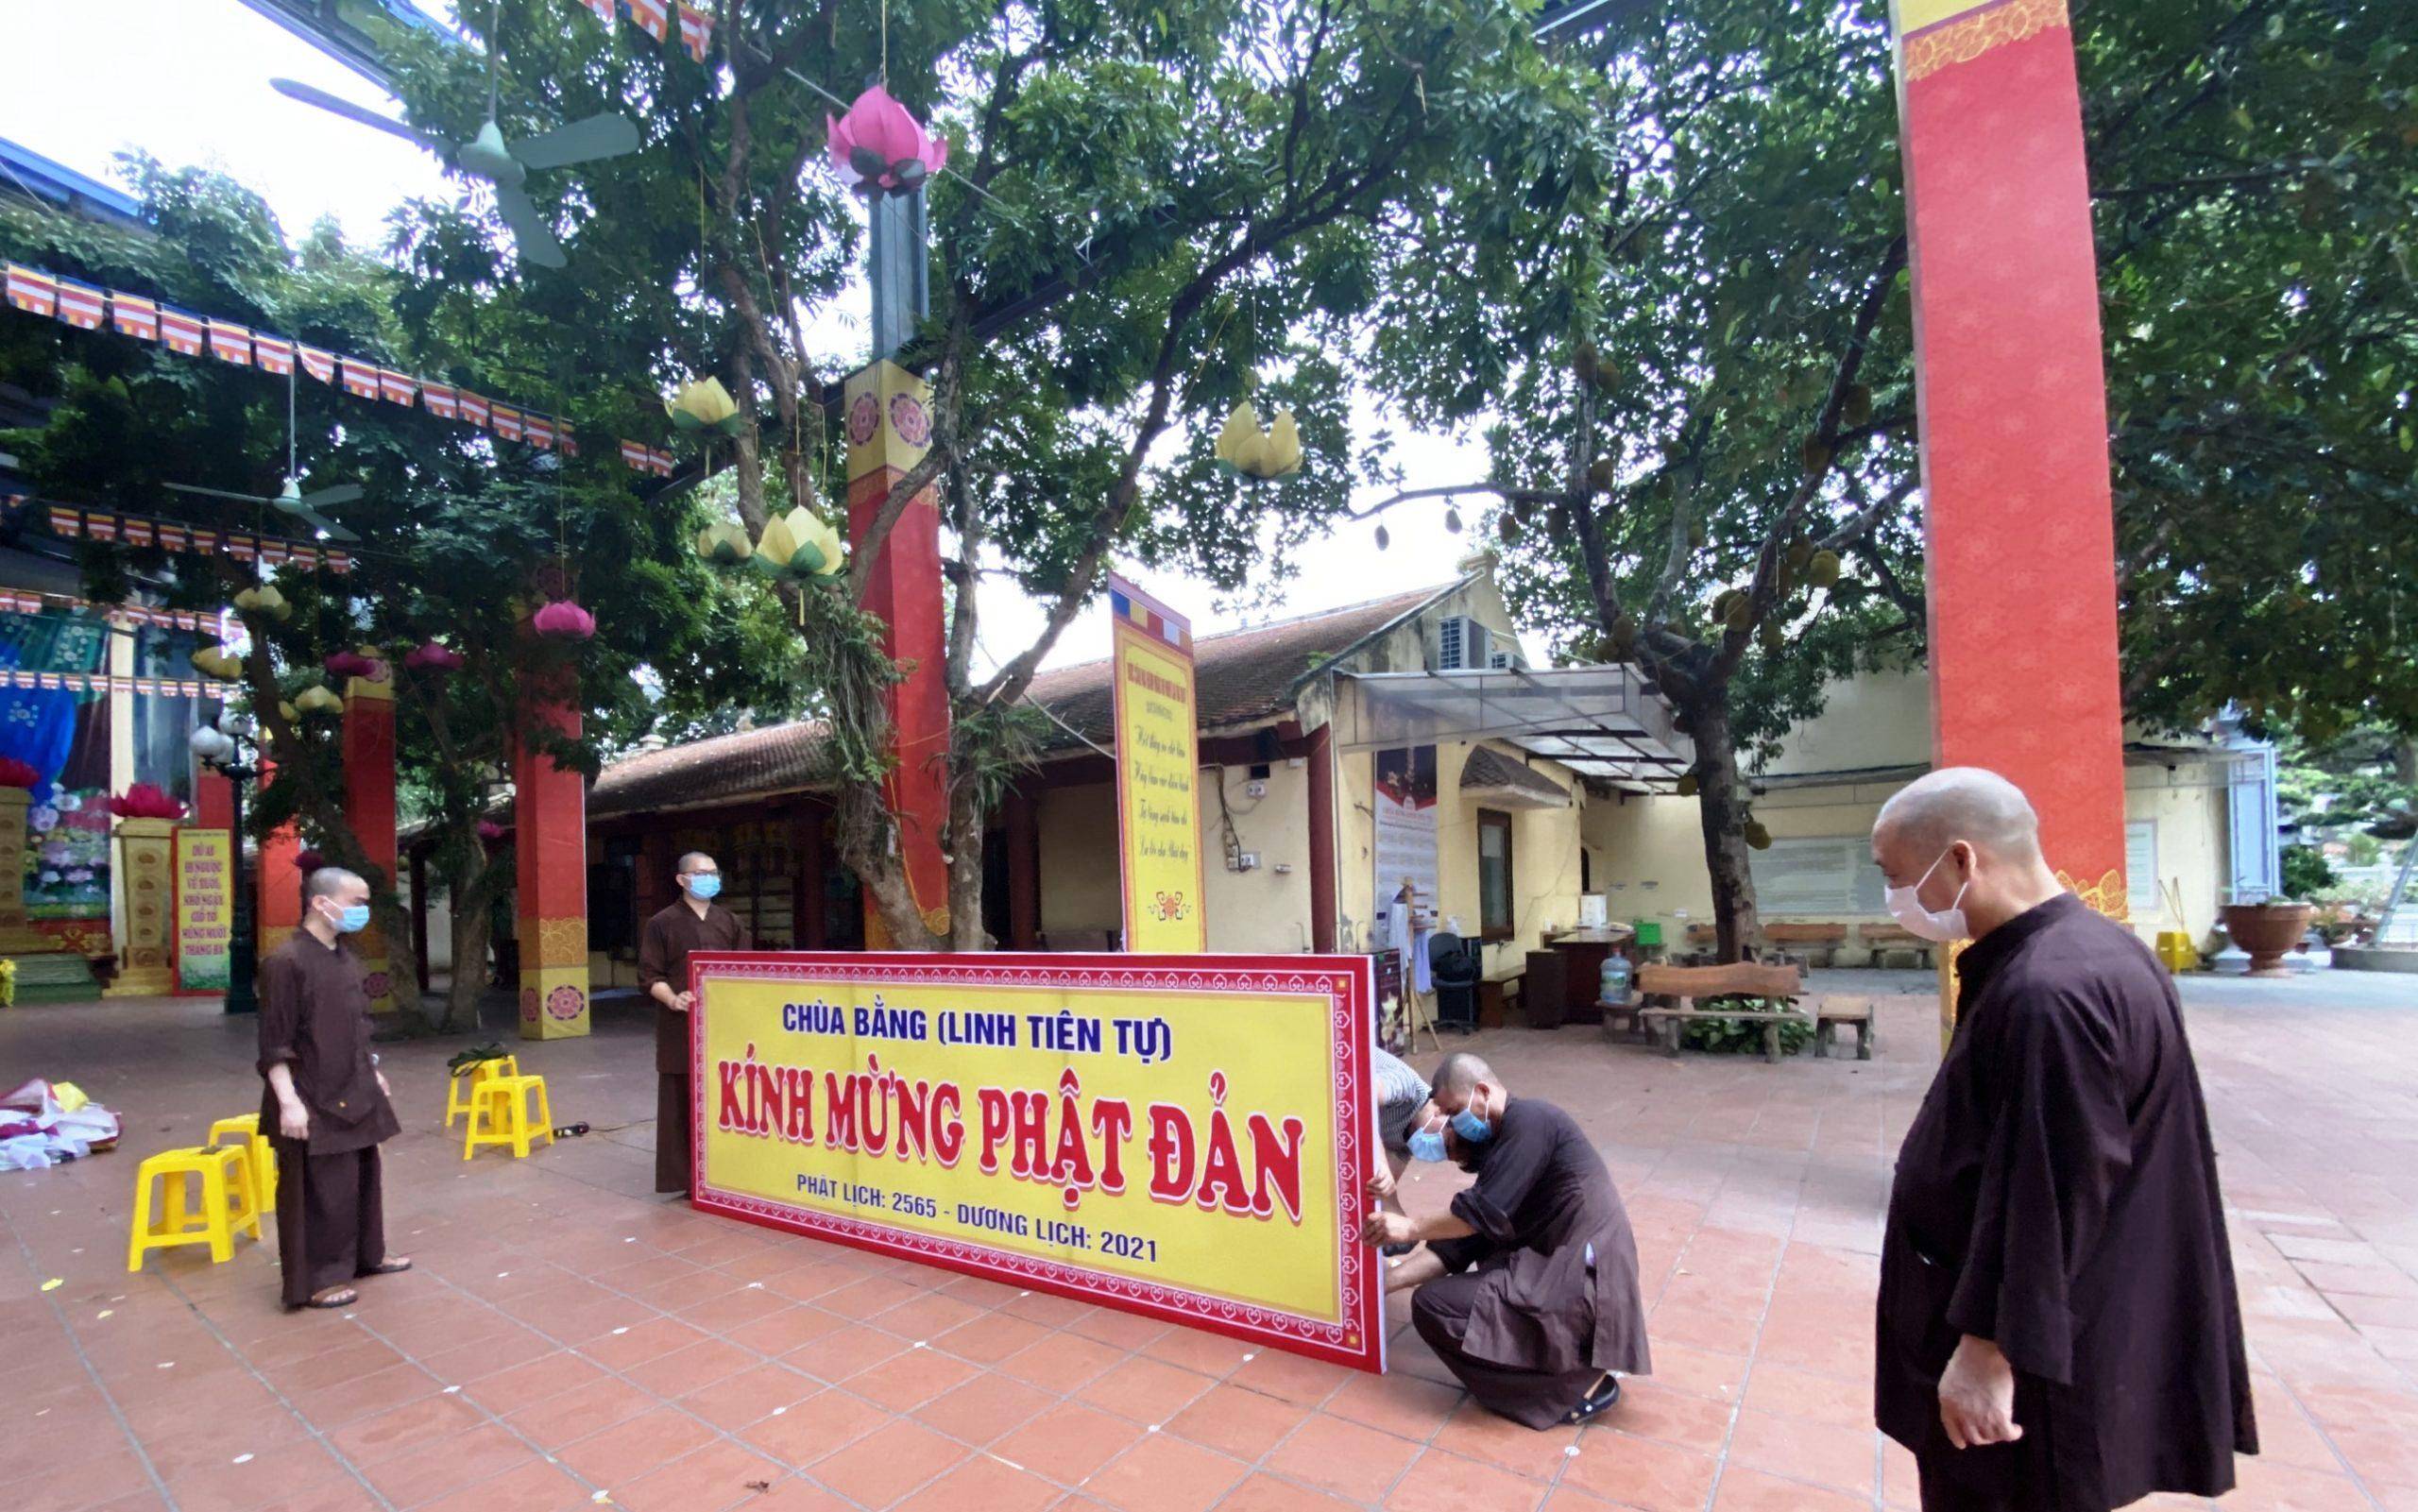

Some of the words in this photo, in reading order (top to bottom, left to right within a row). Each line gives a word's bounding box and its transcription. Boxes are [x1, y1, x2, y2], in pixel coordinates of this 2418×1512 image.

[782, 998, 846, 1035] CHÙA
[854, 994, 928, 1041] BẰNG
[938, 1011, 1017, 1046] (LINH
[1027, 1010, 1101, 1053] TIÊN
[1113, 1016, 1171, 1063] TỰ)
[718, 1043, 814, 1142] KÍNH
[825, 1052, 964, 1166] MỪNG
[978, 1066, 1132, 1209] PHẬT
[1148, 1070, 1304, 1223] ĐẢN
[797, 1174, 837, 1200] PHẬT
[843, 1182, 886, 1209] LỊCH:
[892, 1192, 937, 1218] 2565
[957, 1203, 1028, 1236] DƯƠNG
[1036, 1218, 1091, 1249] LỊCH:
[1100, 1232, 1157, 1262] 2021
